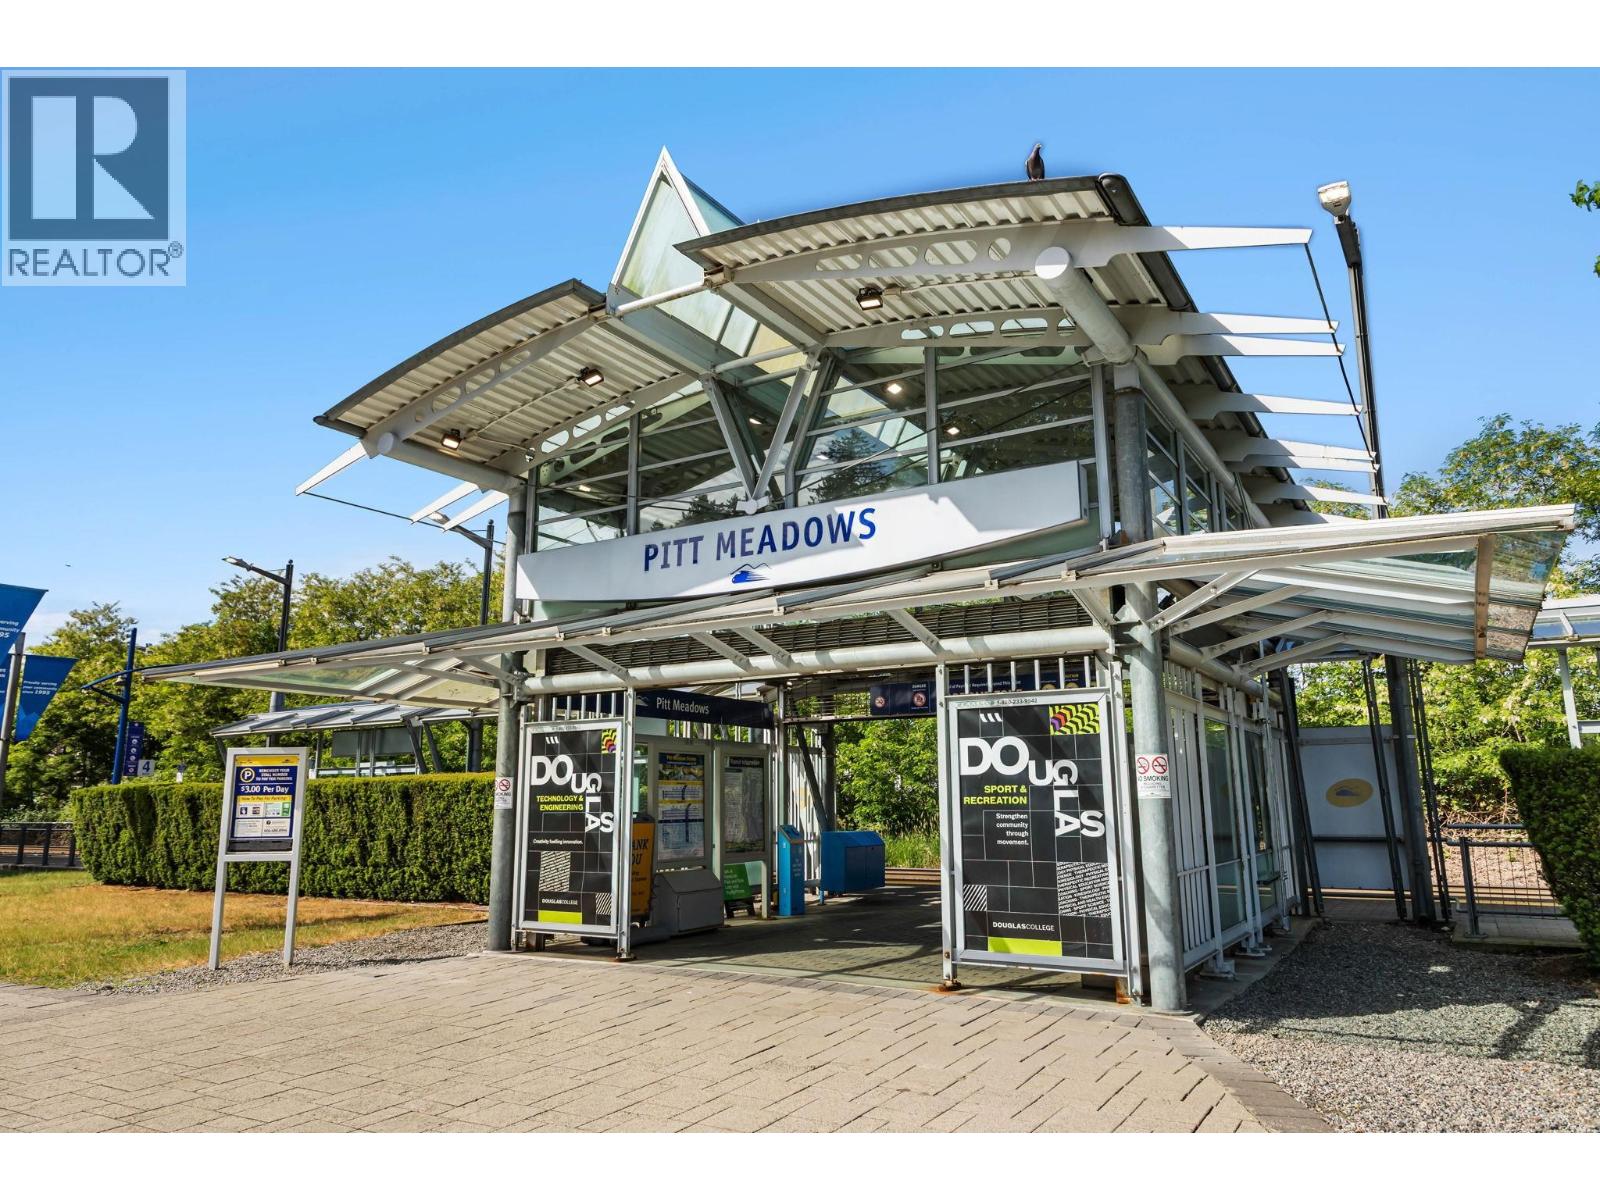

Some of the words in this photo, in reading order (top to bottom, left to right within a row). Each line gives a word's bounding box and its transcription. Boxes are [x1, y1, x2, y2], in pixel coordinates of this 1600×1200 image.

[643, 535, 704, 572] PITT
[716, 507, 876, 561] MEADOWS
[656, 696, 671, 711] Pitt
[672, 700, 710, 714] Meadows
[142, 761, 150, 772] 4
[244, 770, 252, 780] P
[276, 786, 289, 794] Day
[984, 784, 1018, 794] SPORT
[1020, 784, 1027, 793] &
[964, 796, 1027, 805] RECREATION
